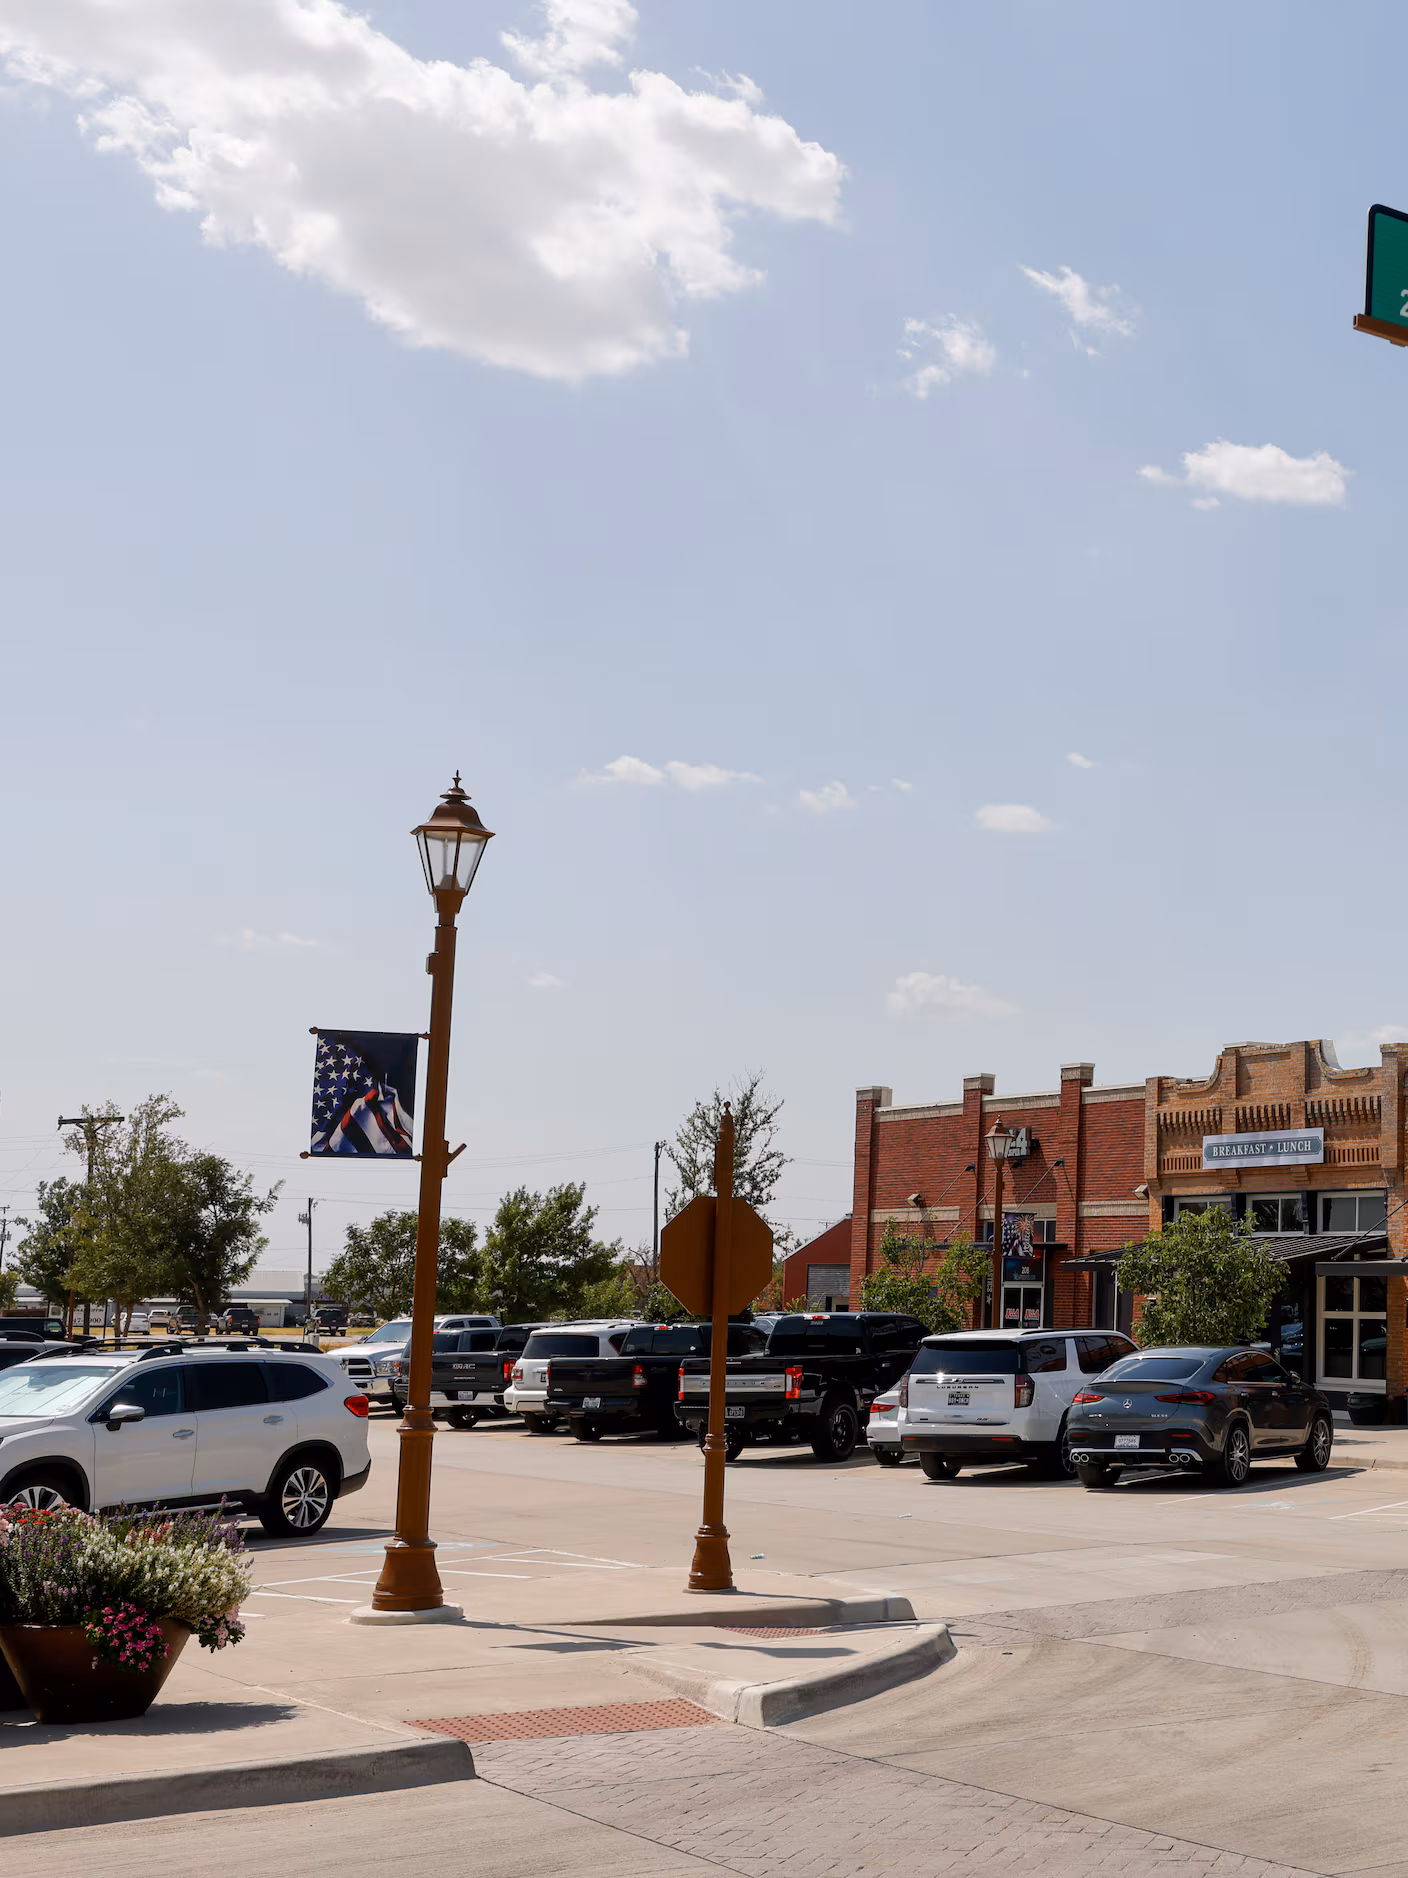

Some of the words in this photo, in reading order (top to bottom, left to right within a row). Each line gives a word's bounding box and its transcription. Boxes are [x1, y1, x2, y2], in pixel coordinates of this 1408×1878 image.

[1212, 1143, 1267, 1157] BREAKFAST
[1277, 1140, 1311, 1153] LUNCH
[1021, 1266, 1030, 1275] 208
